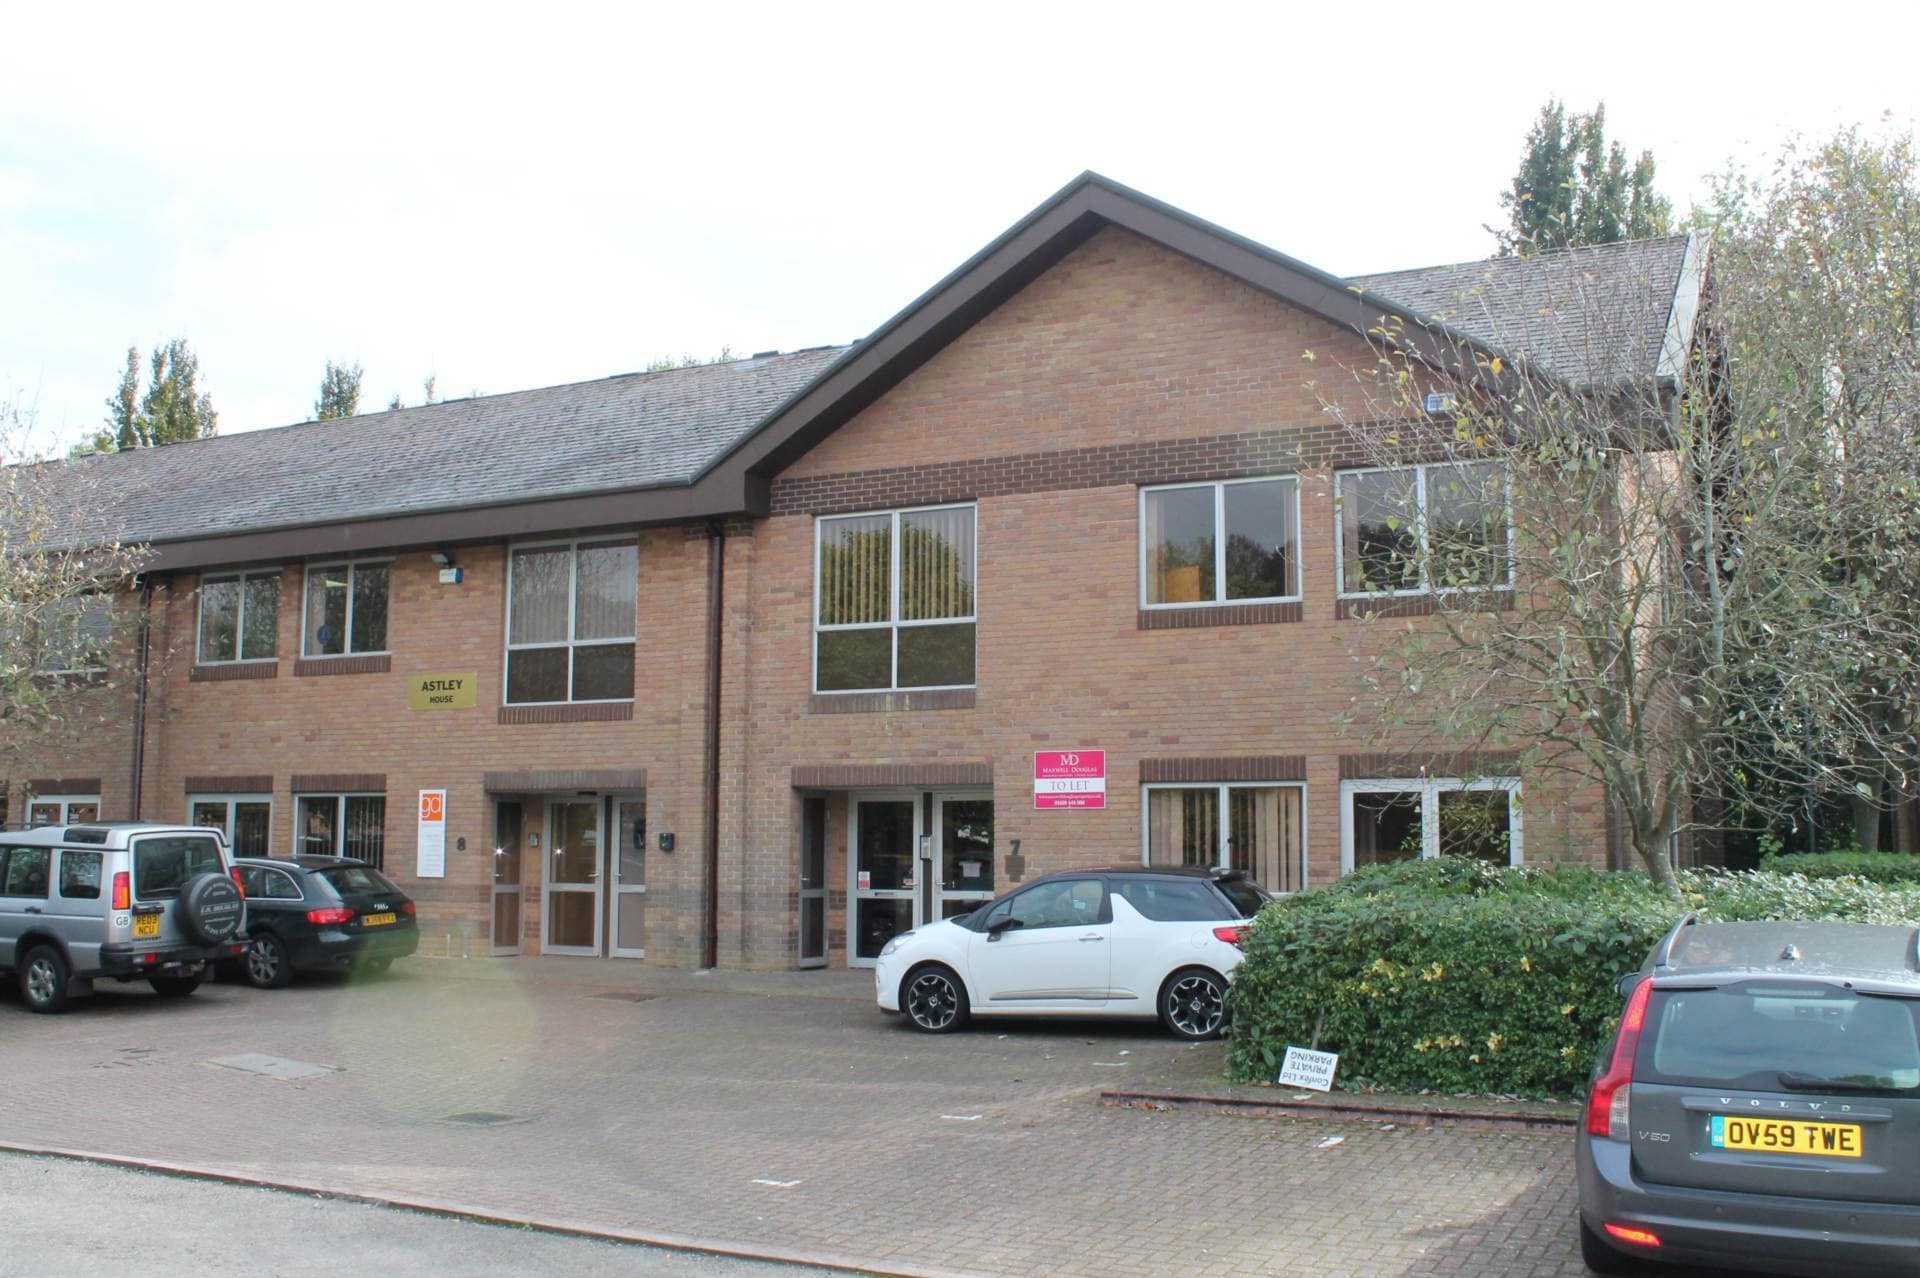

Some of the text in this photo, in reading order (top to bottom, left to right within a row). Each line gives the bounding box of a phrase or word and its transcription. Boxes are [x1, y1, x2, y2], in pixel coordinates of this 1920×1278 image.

[422, 680, 463, 691] ASTLEY
[1049, 780, 1089, 791] TO LET
[1010, 839, 1021, 856] 7
[116, 916, 129, 926] GB
[1290, 1051, 1332, 1065] PARKING
[1290, 1061, 1328, 1075] PRIVATE
[1282, 1071, 1297, 1082] Ltd
[1719, 1097, 1851, 1112] VOLVO
[1638, 1131, 1671, 1142] V50
[1729, 1122, 1796, 1147] OV59
[1803, 1126, 1856, 1151] TWE
